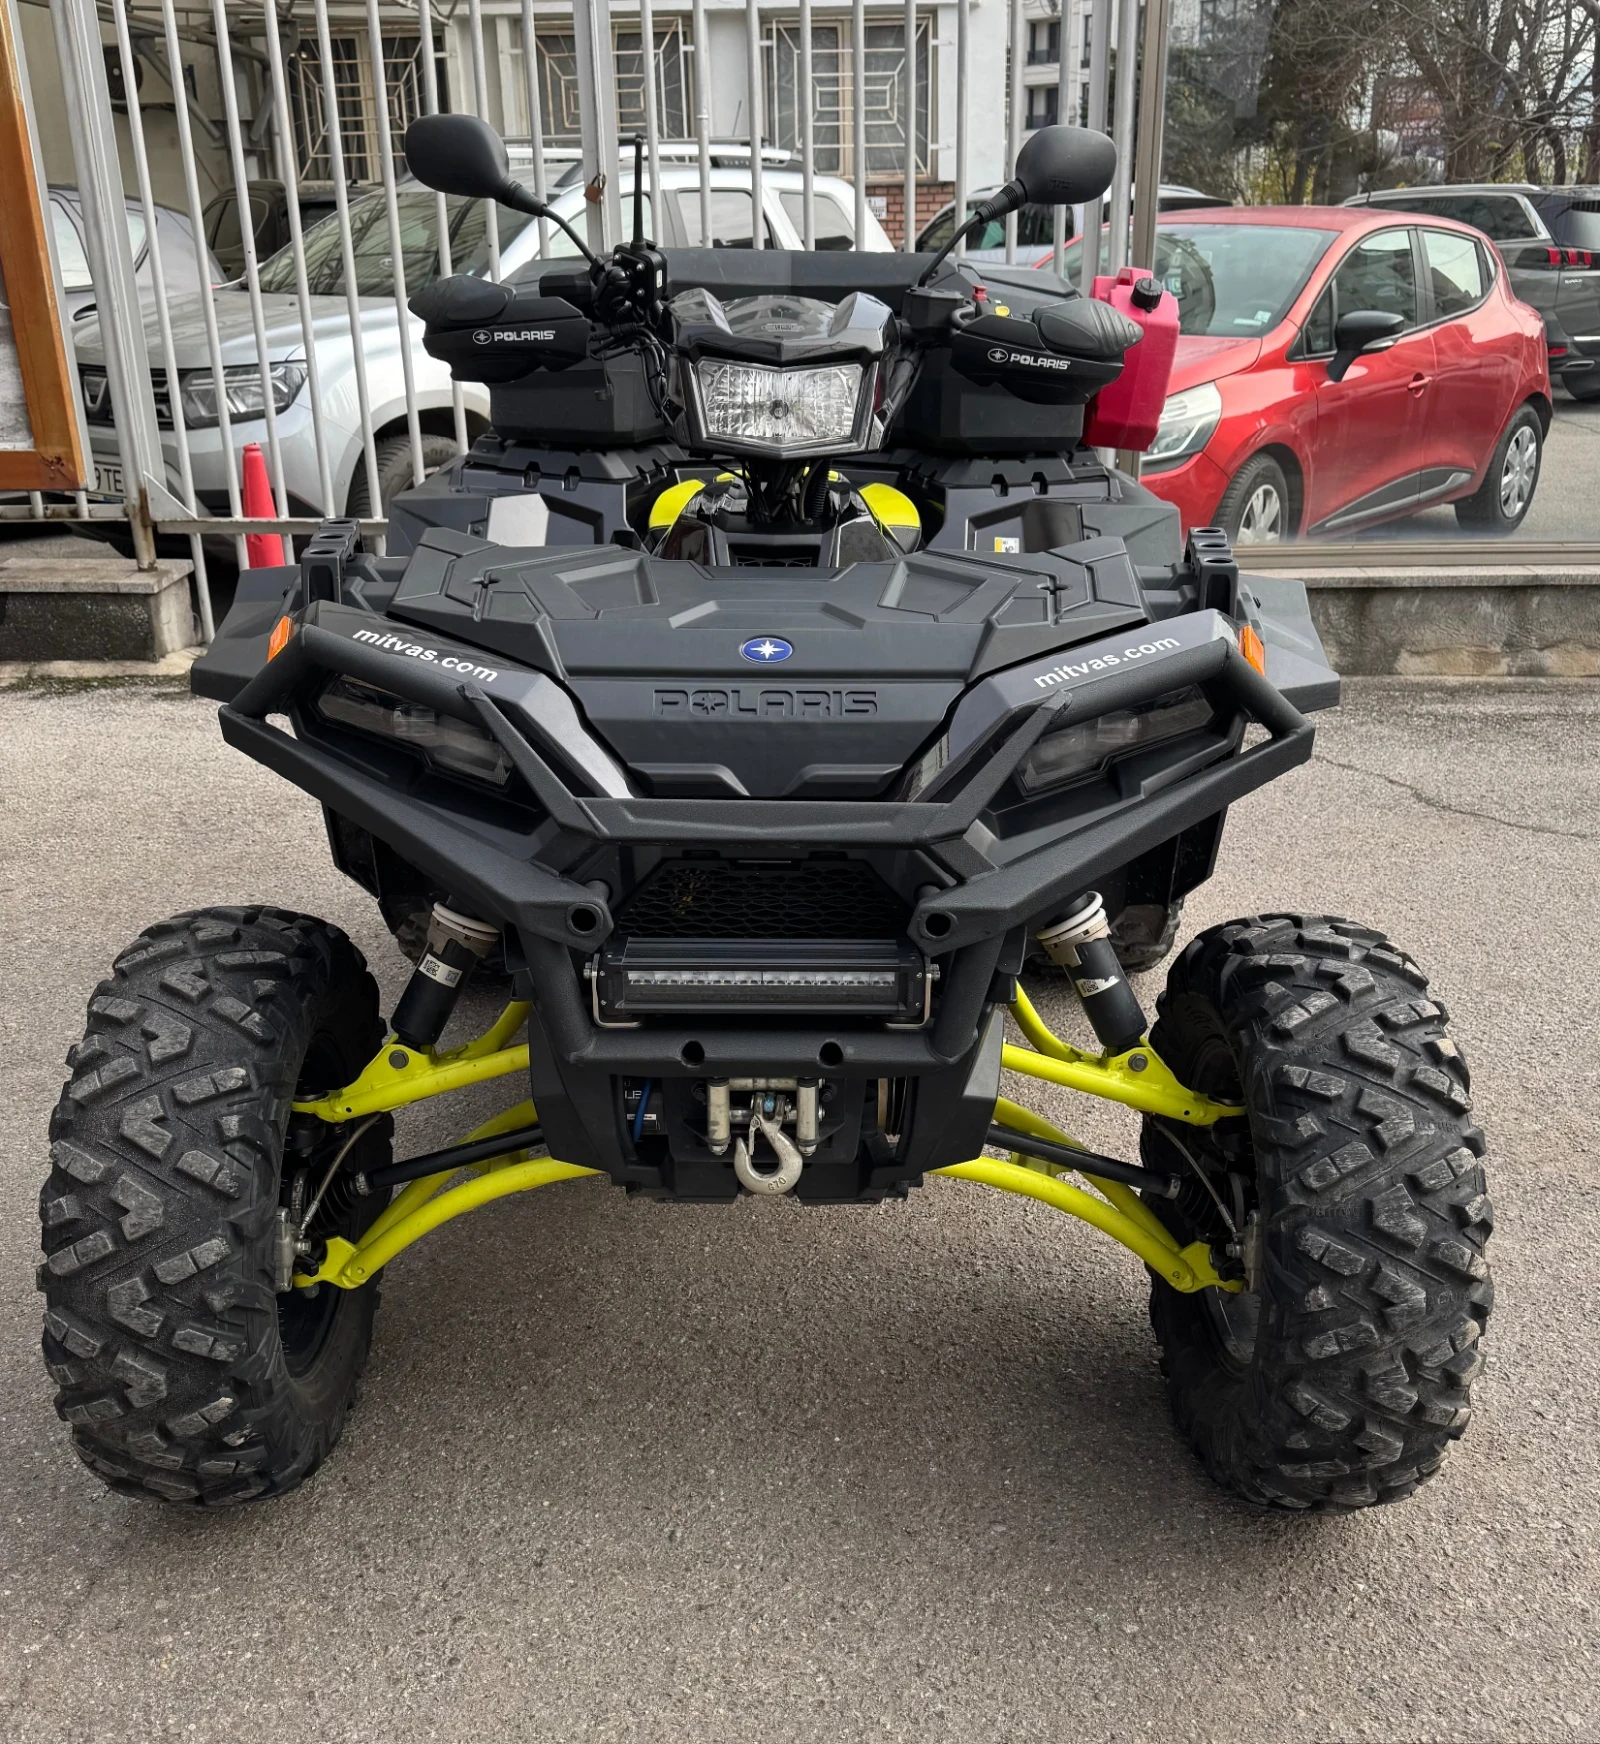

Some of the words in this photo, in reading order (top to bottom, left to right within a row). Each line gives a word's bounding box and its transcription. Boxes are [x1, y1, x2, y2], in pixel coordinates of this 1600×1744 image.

[494, 330, 555, 341] POLARIS
[1010, 353, 1070, 369] POLARIS
[353, 629, 498, 682] mitvas.com
[1034, 638, 1180, 688] mitvas.com
[653, 690, 877, 716] POLARIS
[768, 1177, 787, 1191] G70
